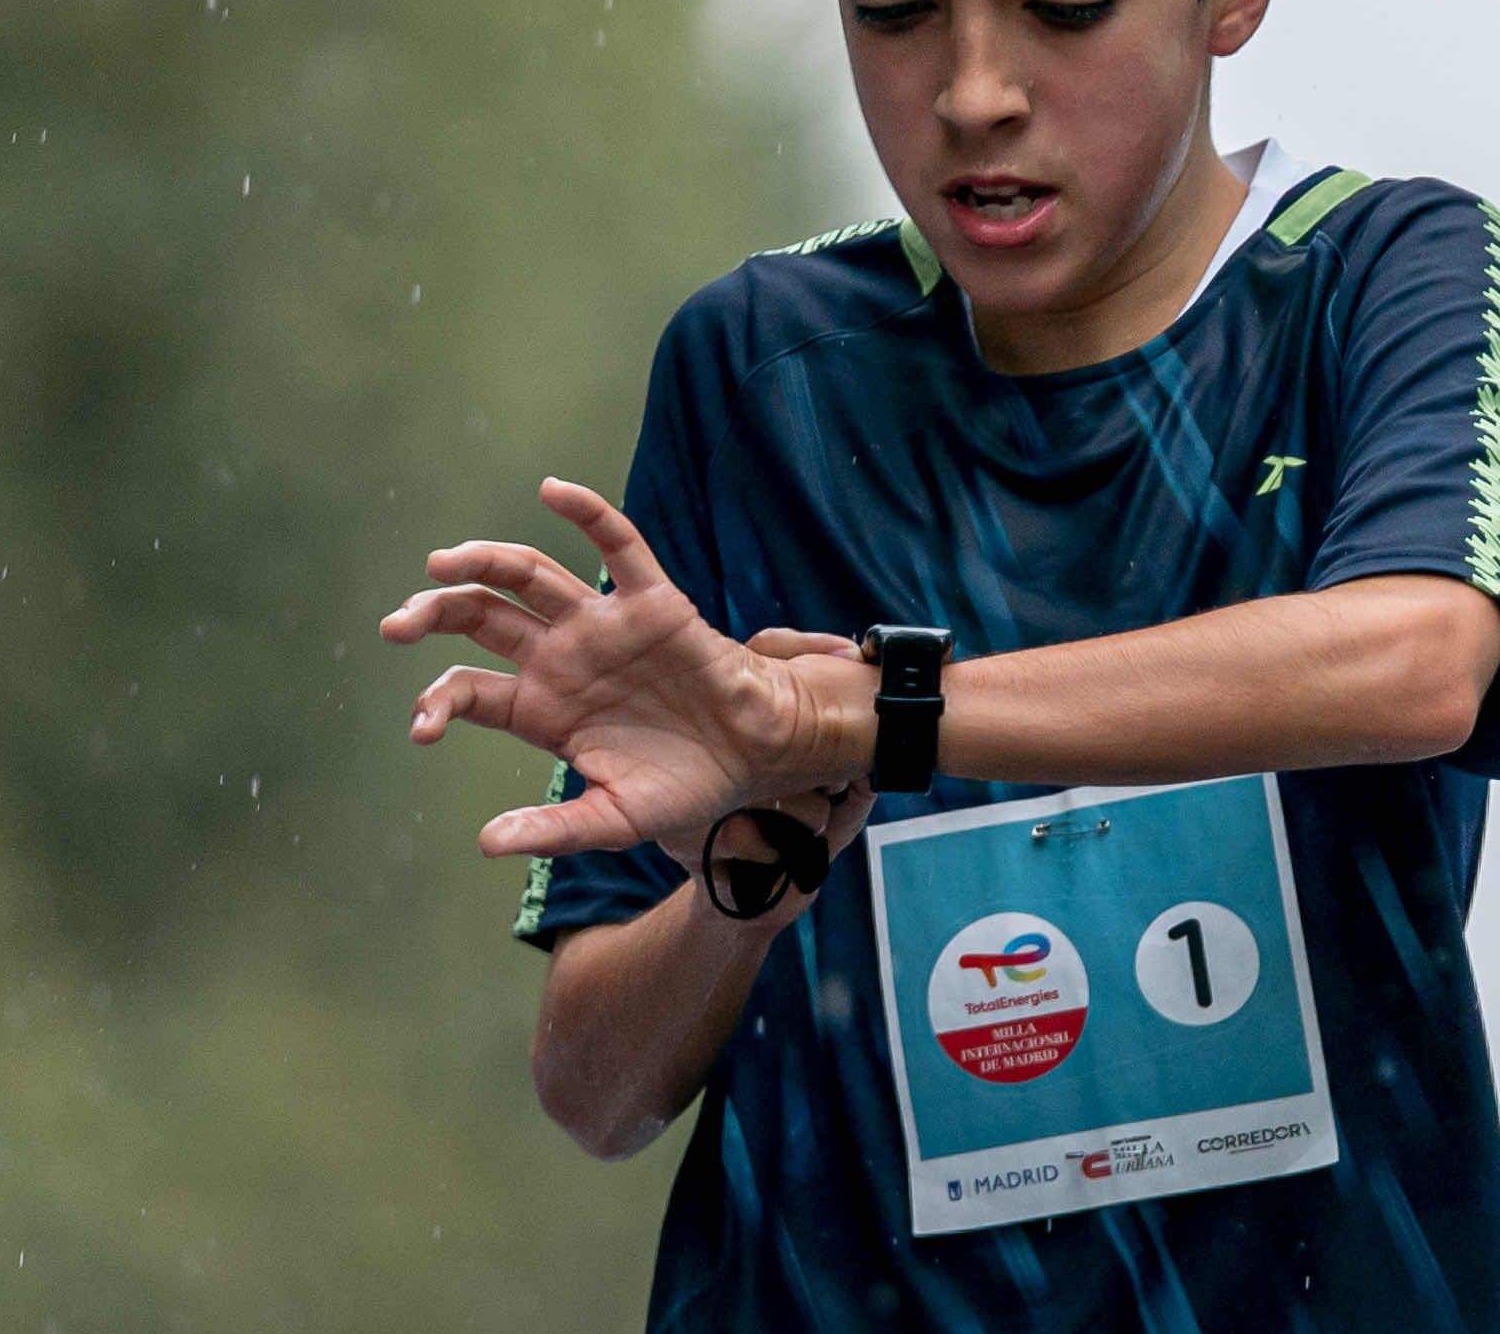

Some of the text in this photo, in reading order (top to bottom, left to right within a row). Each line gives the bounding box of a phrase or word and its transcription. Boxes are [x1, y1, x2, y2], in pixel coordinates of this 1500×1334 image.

[1167, 917, 1213, 1009] 1
[964, 988, 1060, 1016] TotalEnergies
[992, 1021, 1037, 1040] MILLA
[960, 1030, 1073, 1063] INTERNACIONAL
[979, 1048, 1059, 1074] DE MADRID
[974, 1164, 1059, 1196] MADRID
